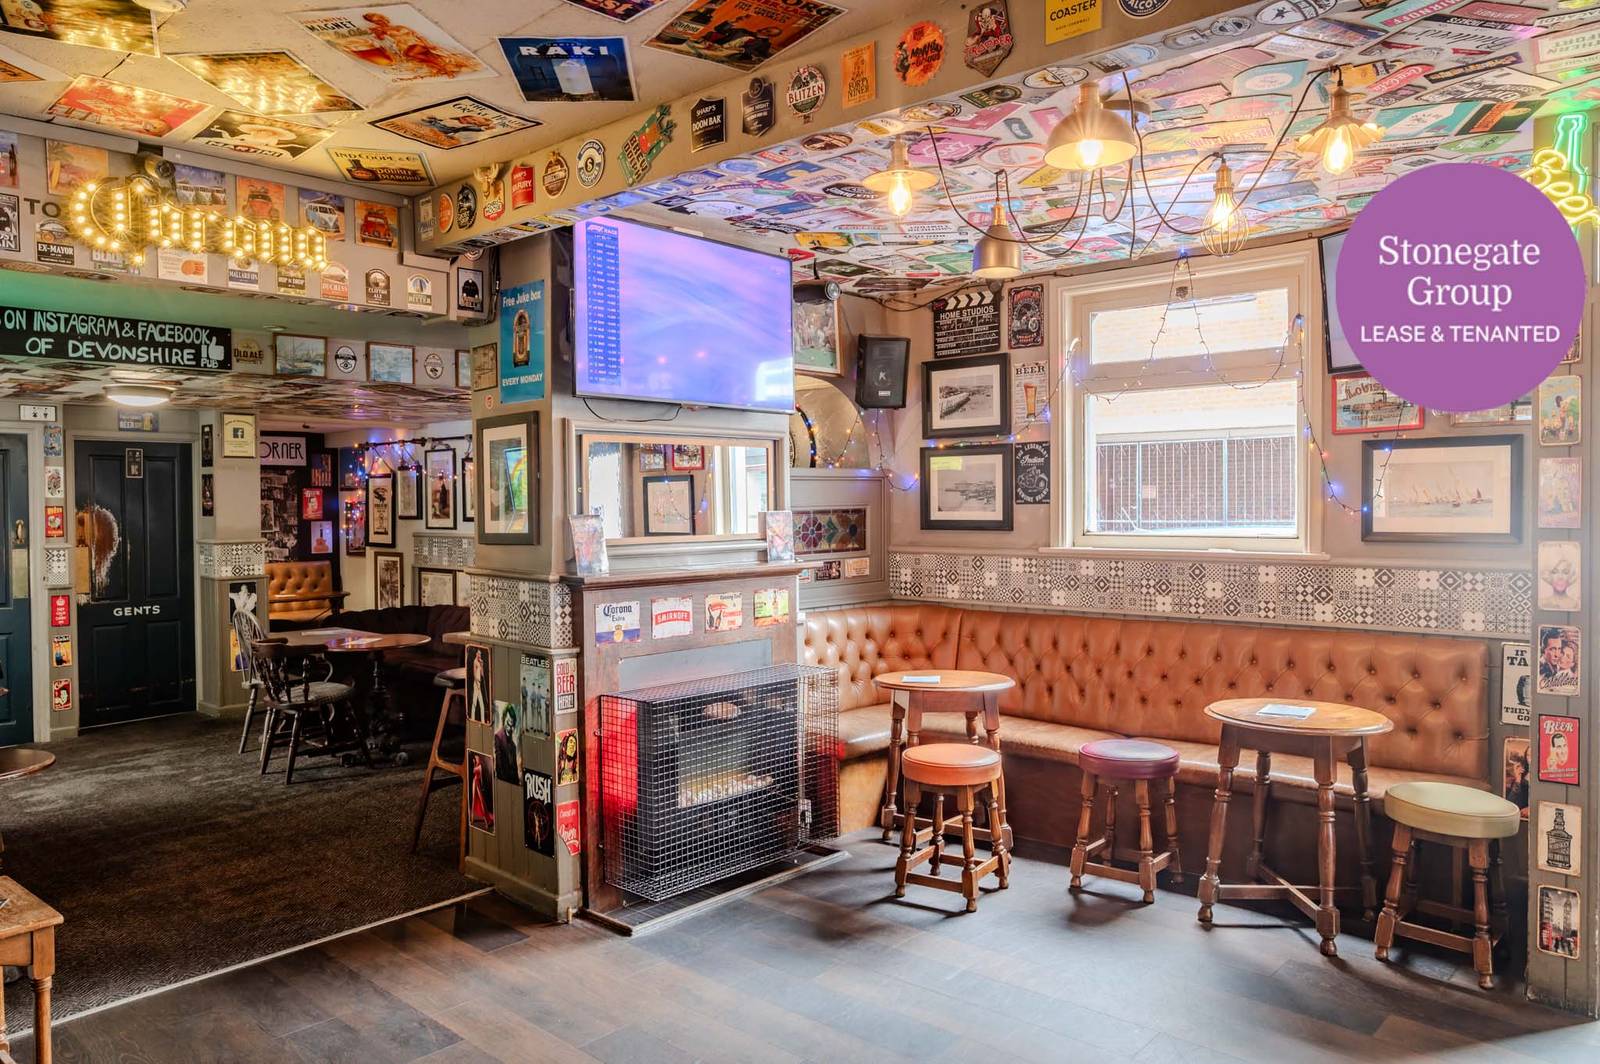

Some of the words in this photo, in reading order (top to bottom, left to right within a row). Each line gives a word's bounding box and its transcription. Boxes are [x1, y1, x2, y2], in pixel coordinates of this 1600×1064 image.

[1049, 0, 1097, 22] COASTER
[305, 21, 358, 33] MAGNET
[519, 45, 609, 57] RAKI
[788, 82, 824, 104] BLITZEN
[696, 104, 717, 117] SHARP'S
[692, 117, 709, 131] DOOM
[709, 115, 722, 126] BAR
[206, 141, 284, 158] MARTINI
[629, 136, 648, 172] BREW
[377, 168, 412, 176] DOUBLE
[23, 198, 62, 218] TO
[38, 243, 74, 255] EX-MAYOR
[408, 296, 431, 304] BITTER
[502, 296, 515, 308] Free
[516, 293, 529, 305] Juke
[530, 290, 541, 301] box
[940, 311, 961, 320] HOME
[962, 305, 994, 317] STUDIOS
[4, 309, 27, 331] ON
[33, 311, 120, 339] INSTAGRAM
[122, 322, 136, 338] &
[138, 321, 211, 346] FACEBOOK
[25, 337, 54, 355] OF
[68, 340, 197, 366] DEVONSHIRE
[234, 348, 249, 359] OLD
[250, 349, 265, 360] ALE
[200, 358, 219, 369] PUB
[1015, 365, 1045, 375] BEER
[502, 376, 519, 387] EVERY
[520, 372, 543, 386] MONDAY
[1342, 382, 1386, 401] Lobs
[1020, 454, 1045, 465] Indian
[113, 605, 161, 616] GENTS
[603, 603, 632, 617] Corona
[611, 615, 625, 623] Extra
[657, 612, 689, 623] SMIRNOFF
[521, 655, 550, 669] BEATLES
[1507, 656, 1529, 666] TA
[557, 661, 570, 676] COLD
[557, 674, 575, 694] BEER
[1543, 719, 1575, 735] BEER
[525, 773, 552, 805] RUSH
